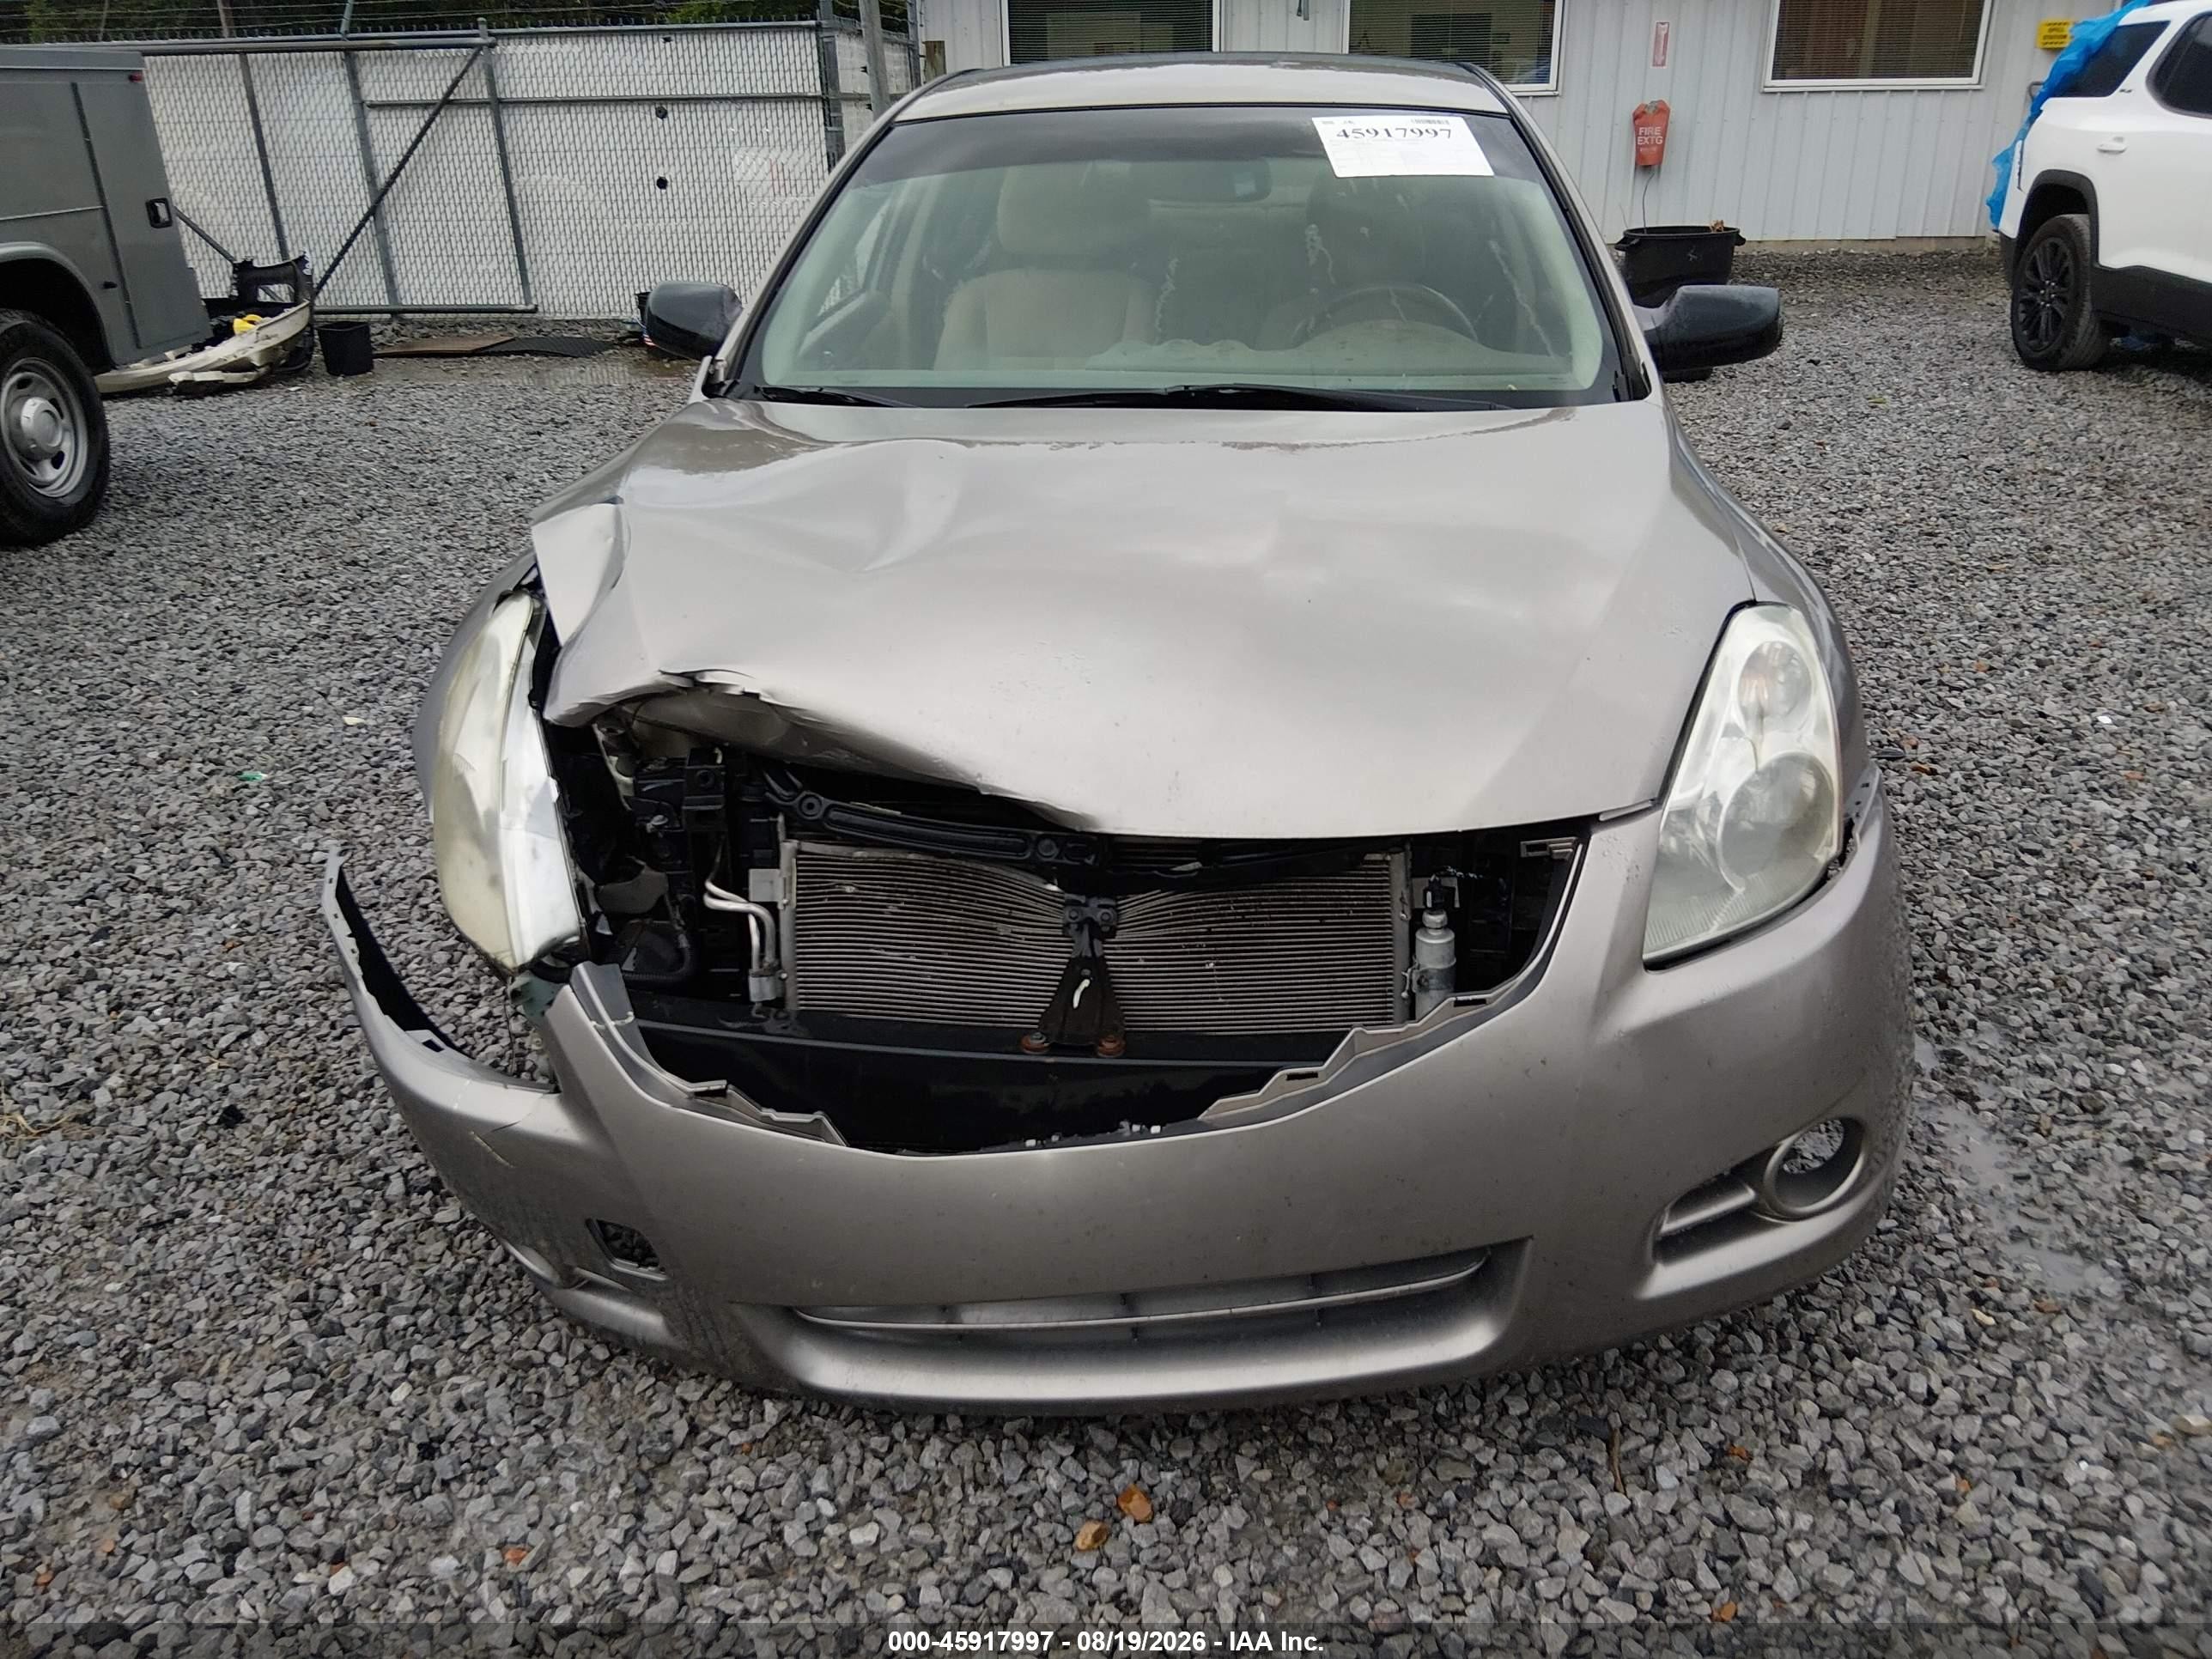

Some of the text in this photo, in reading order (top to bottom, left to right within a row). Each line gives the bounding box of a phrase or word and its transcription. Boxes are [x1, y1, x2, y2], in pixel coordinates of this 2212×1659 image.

[1336, 127, 1452, 139] 45917997
[1638, 126, 1662, 136] FIRE
[1638, 136, 1663, 145] EXTG
